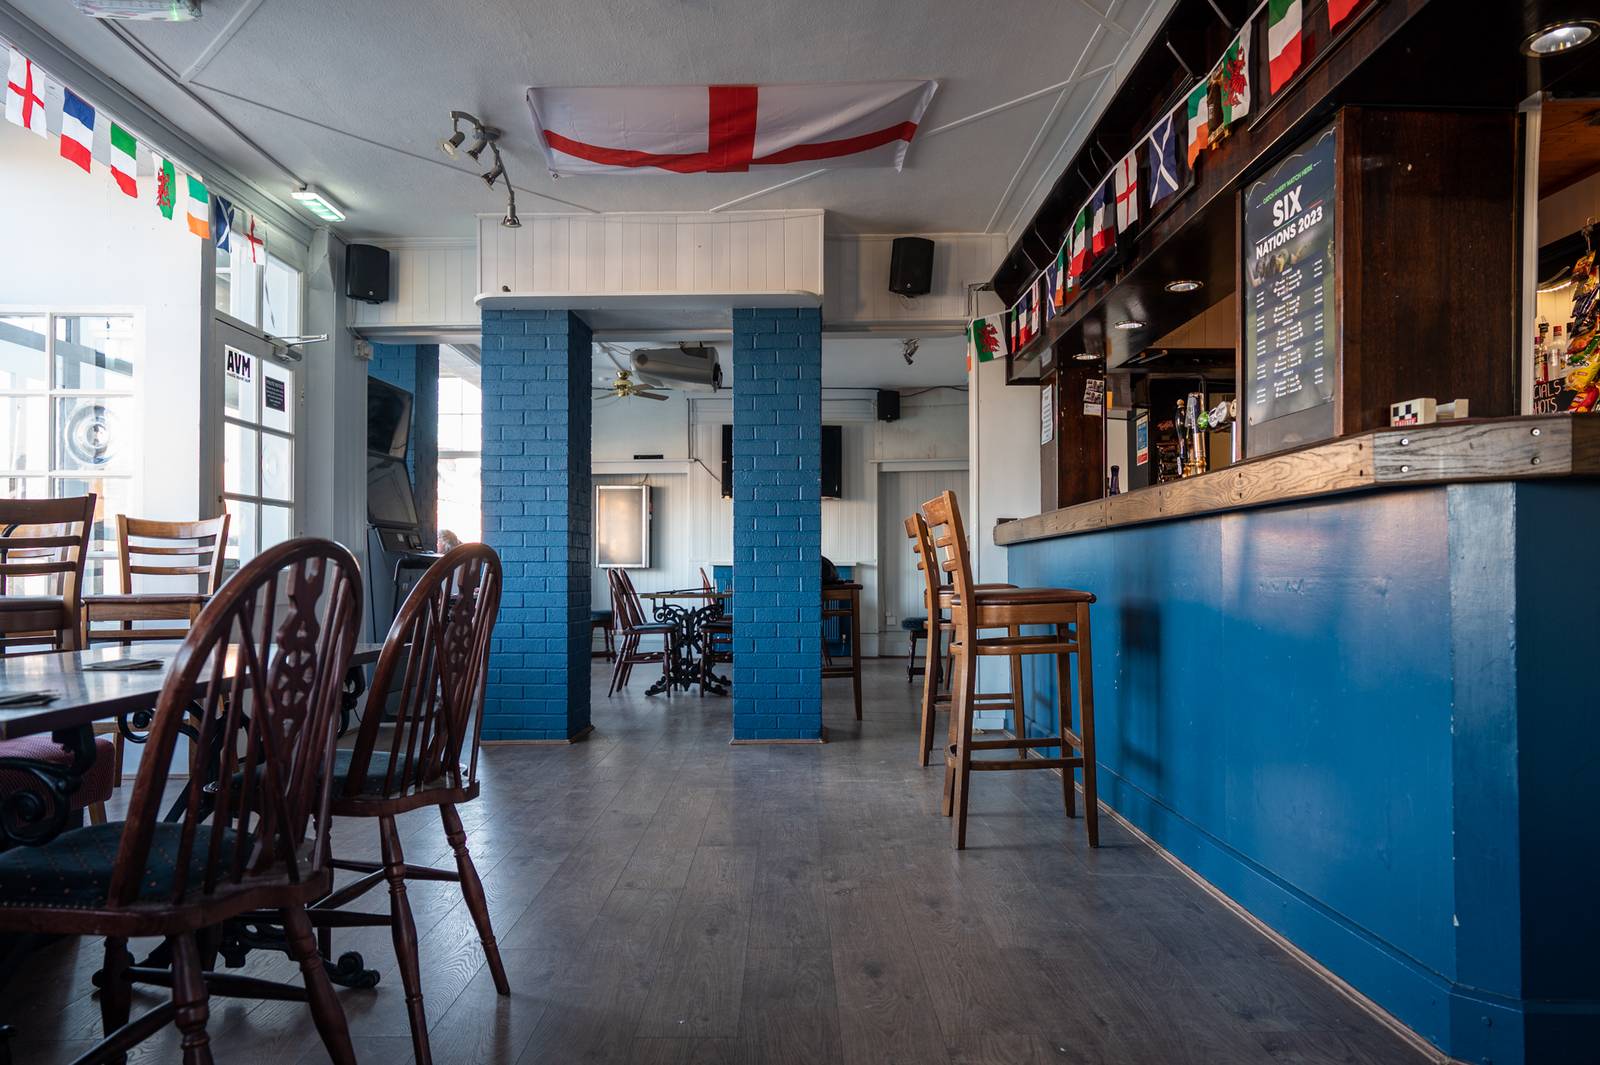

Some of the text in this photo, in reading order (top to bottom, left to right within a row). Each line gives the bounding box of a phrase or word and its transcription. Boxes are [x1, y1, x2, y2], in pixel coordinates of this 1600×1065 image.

[1273, 184, 1302, 227] SIX
[1256, 206, 1323, 260] NATIONS 2023
[1534, 380, 1562, 400] CIALS
[1533, 397, 1558, 416] HOTS
